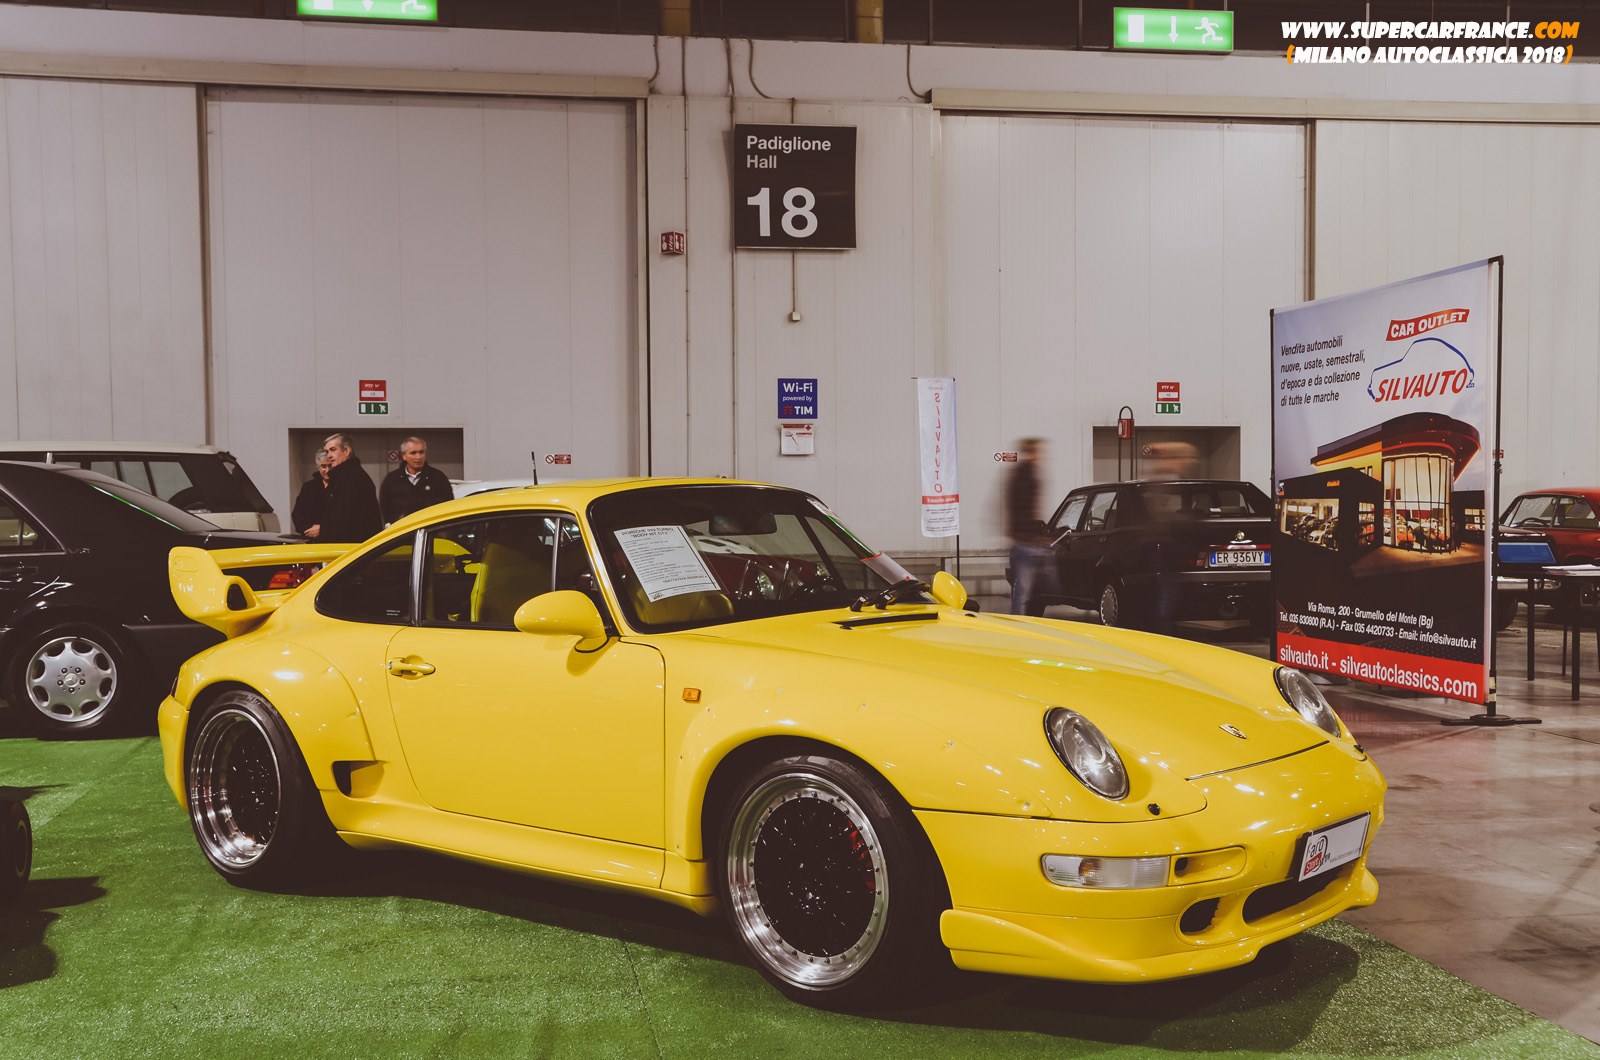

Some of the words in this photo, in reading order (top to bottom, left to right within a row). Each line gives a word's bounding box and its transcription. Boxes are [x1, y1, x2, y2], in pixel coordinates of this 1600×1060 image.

[747, 135, 831, 154] Padiglione
[747, 155, 777, 169] Hall
[747, 187, 818, 238] 18
[1390, 321, 1415, 338] CAR
[1418, 311, 1466, 332] OUTLET
[1281, 342, 1306, 356] Vendita
[1306, 335, 1343, 353] automobili
[1280, 362, 1301, 373] nuove,
[1304, 358, 1324, 370] usate,
[1326, 349, 1365, 367] semestrali,
[783, 382, 813, 393] Wi-Fi
[1280, 378, 1306, 391] d'epoca
[1307, 378, 1313, 386] e
[1314, 374, 1322, 386] da
[1324, 371, 1360, 384] collezione
[1375, 368, 1468, 403] SILVAUTO
[1280, 396, 1287, 407] di
[1288, 396, 1303, 406] tutte
[1304, 393, 1311, 404] le
[1313, 390, 1340, 404] marche
[794, 406, 813, 415] TIM
[1217, 552, 1229, 563] ER
[1233, 551, 1263, 563] 936VY
[1307, 602, 1317, 612] Via
[1318, 603, 1337, 616] Roma,
[1338, 605, 1351, 616] 200
[1354, 607, 1384, 621] Grumello
[1386, 611, 1398, 622] del
[1398, 612, 1417, 625] Monte
[1418, 614, 1434, 629] (Bg)
[1280, 611, 1288, 622] Tel.
[1289, 613, 1298, 624] 035
[1319, 618, 1335, 631] (R.A.)
[1340, 621, 1353, 631] Fax
[1354, 622, 1365, 633] 035
[1366, 623, 1394, 637] 4420733
[1398, 628, 1418, 641] Email:
[1419, 631, 1477, 649] info@silvauto.it
[1280, 644, 1329, 670] silvauto.it
[1340, 655, 1477, 698] silvautoclassics.com
